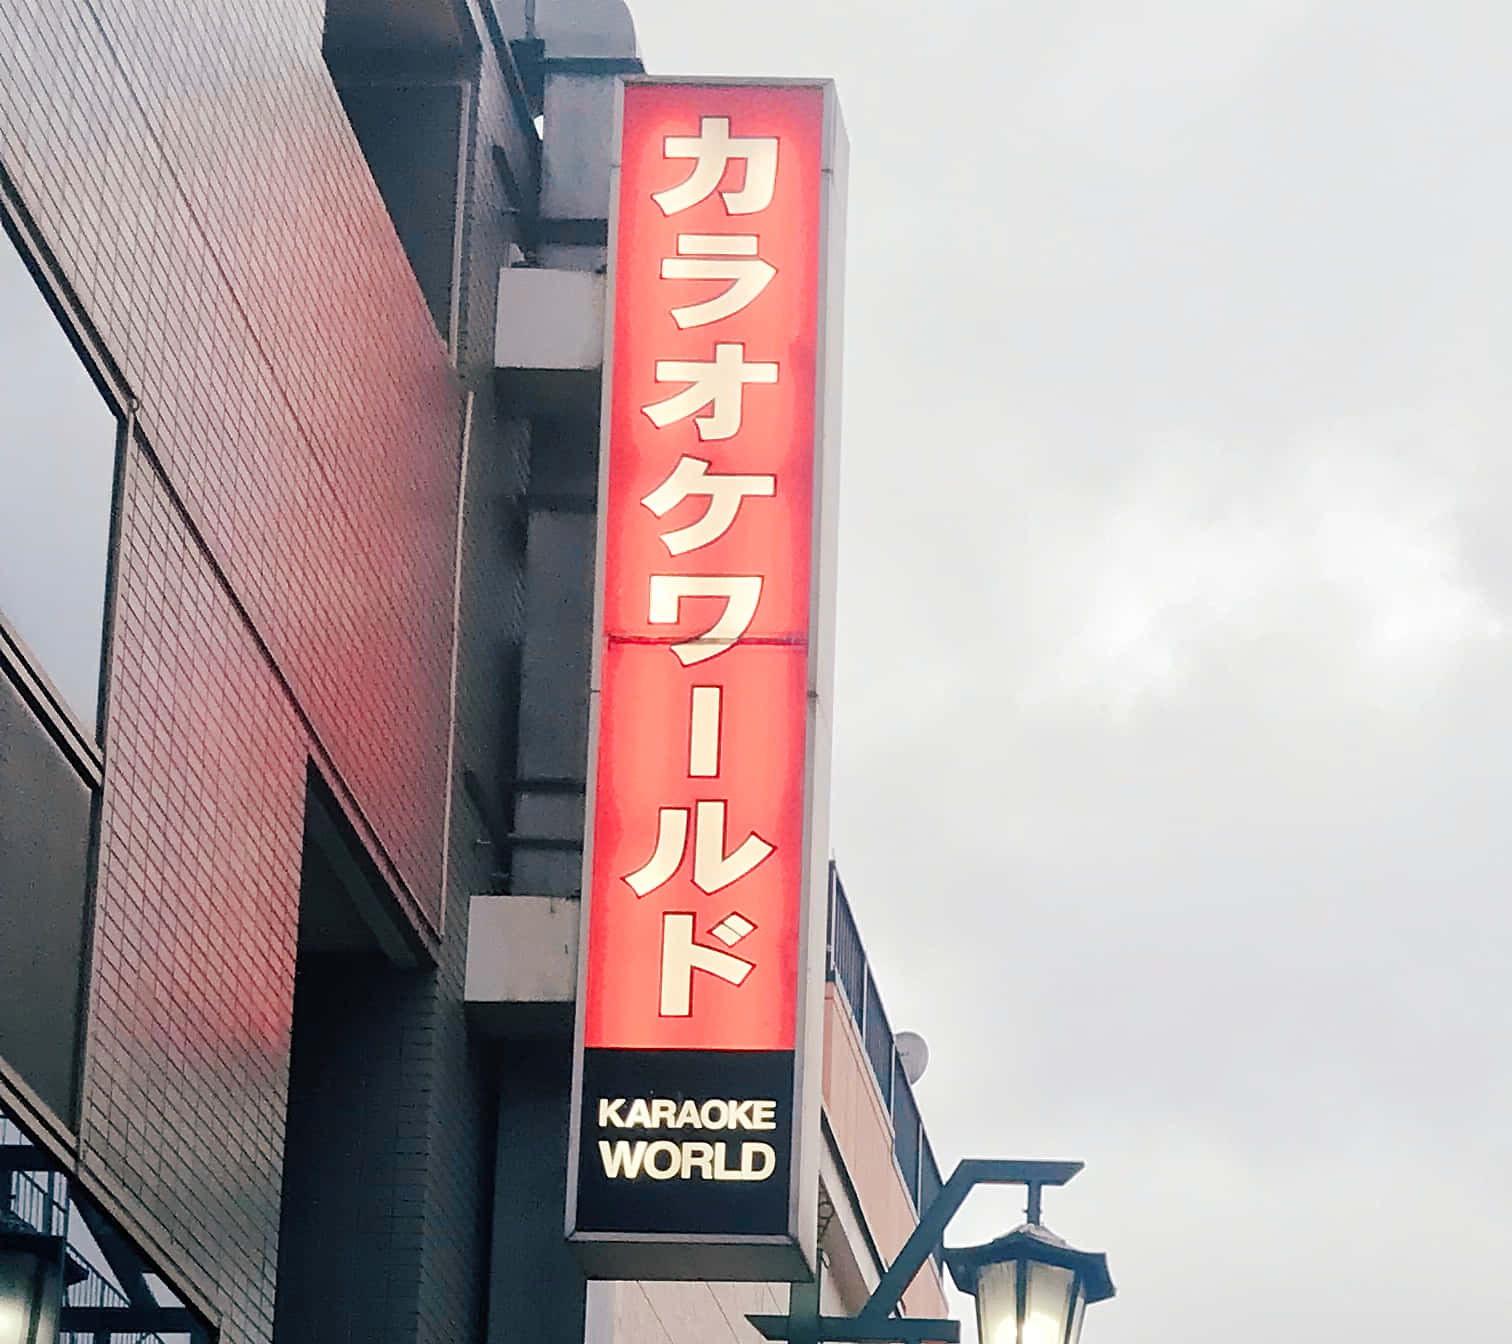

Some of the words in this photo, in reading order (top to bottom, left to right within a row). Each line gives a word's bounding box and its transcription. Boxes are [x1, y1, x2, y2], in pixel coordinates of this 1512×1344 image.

[621, 116, 778, 1018] カラオケワールド
[598, 1096, 777, 1131] KARAOKE
[598, 1139, 777, 1182] WORLD
